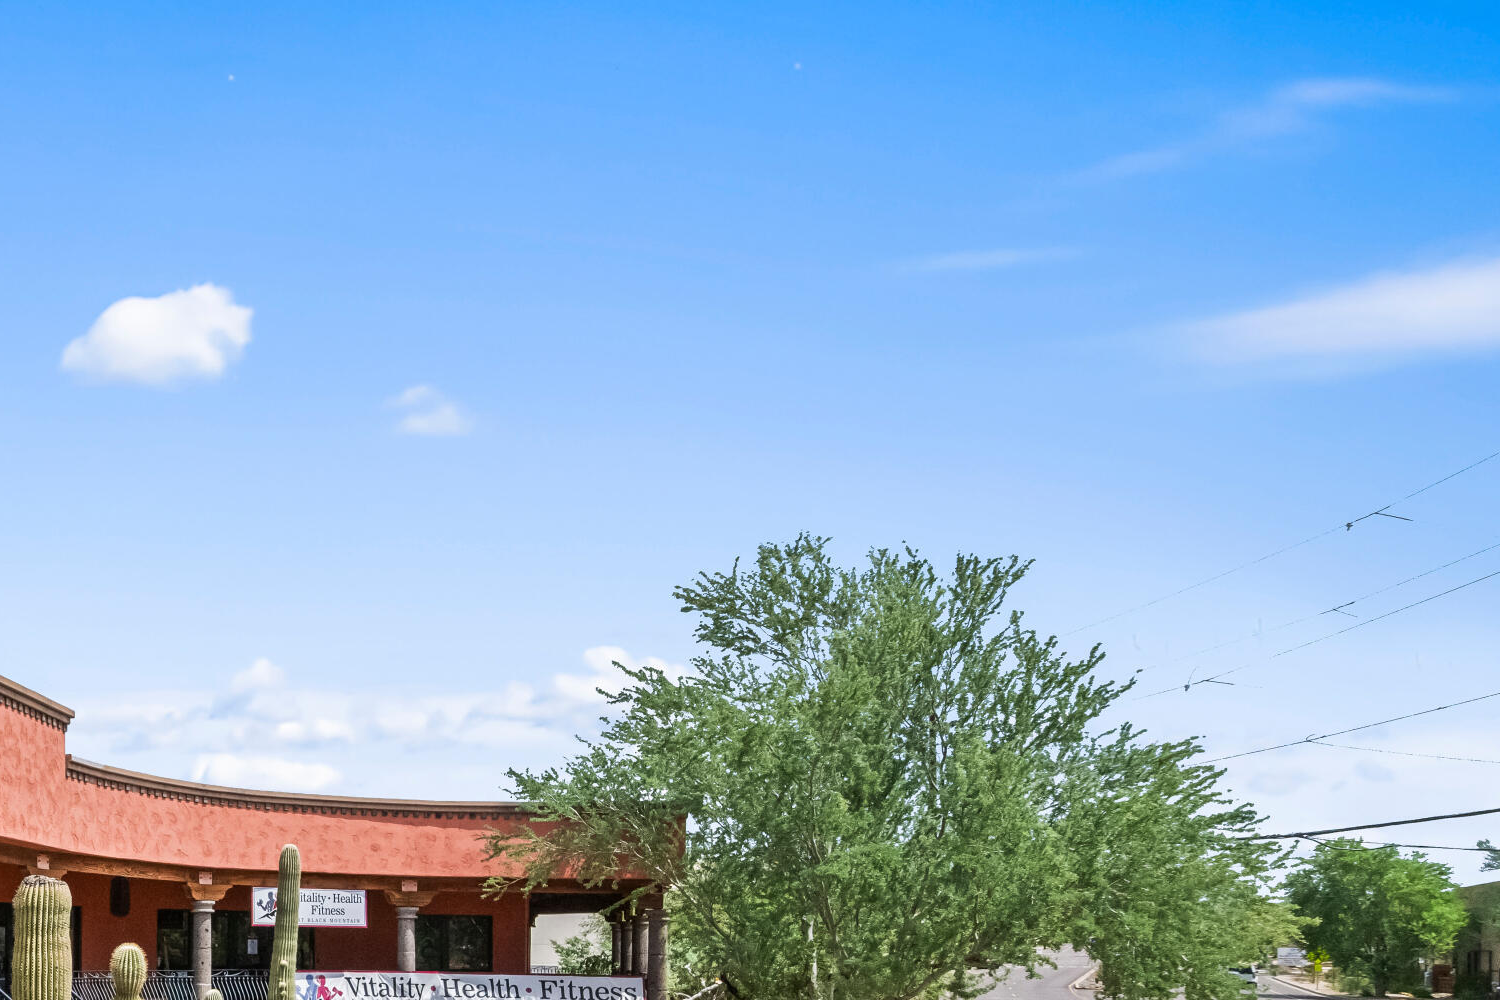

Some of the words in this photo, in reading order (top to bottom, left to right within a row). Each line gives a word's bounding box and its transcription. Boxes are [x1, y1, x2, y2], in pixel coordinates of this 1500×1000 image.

[300, 893, 327, 904] itality
[333, 893, 362, 904] Health
[311, 903, 346, 916] Fitness
[441, 978, 521, 999] Health
